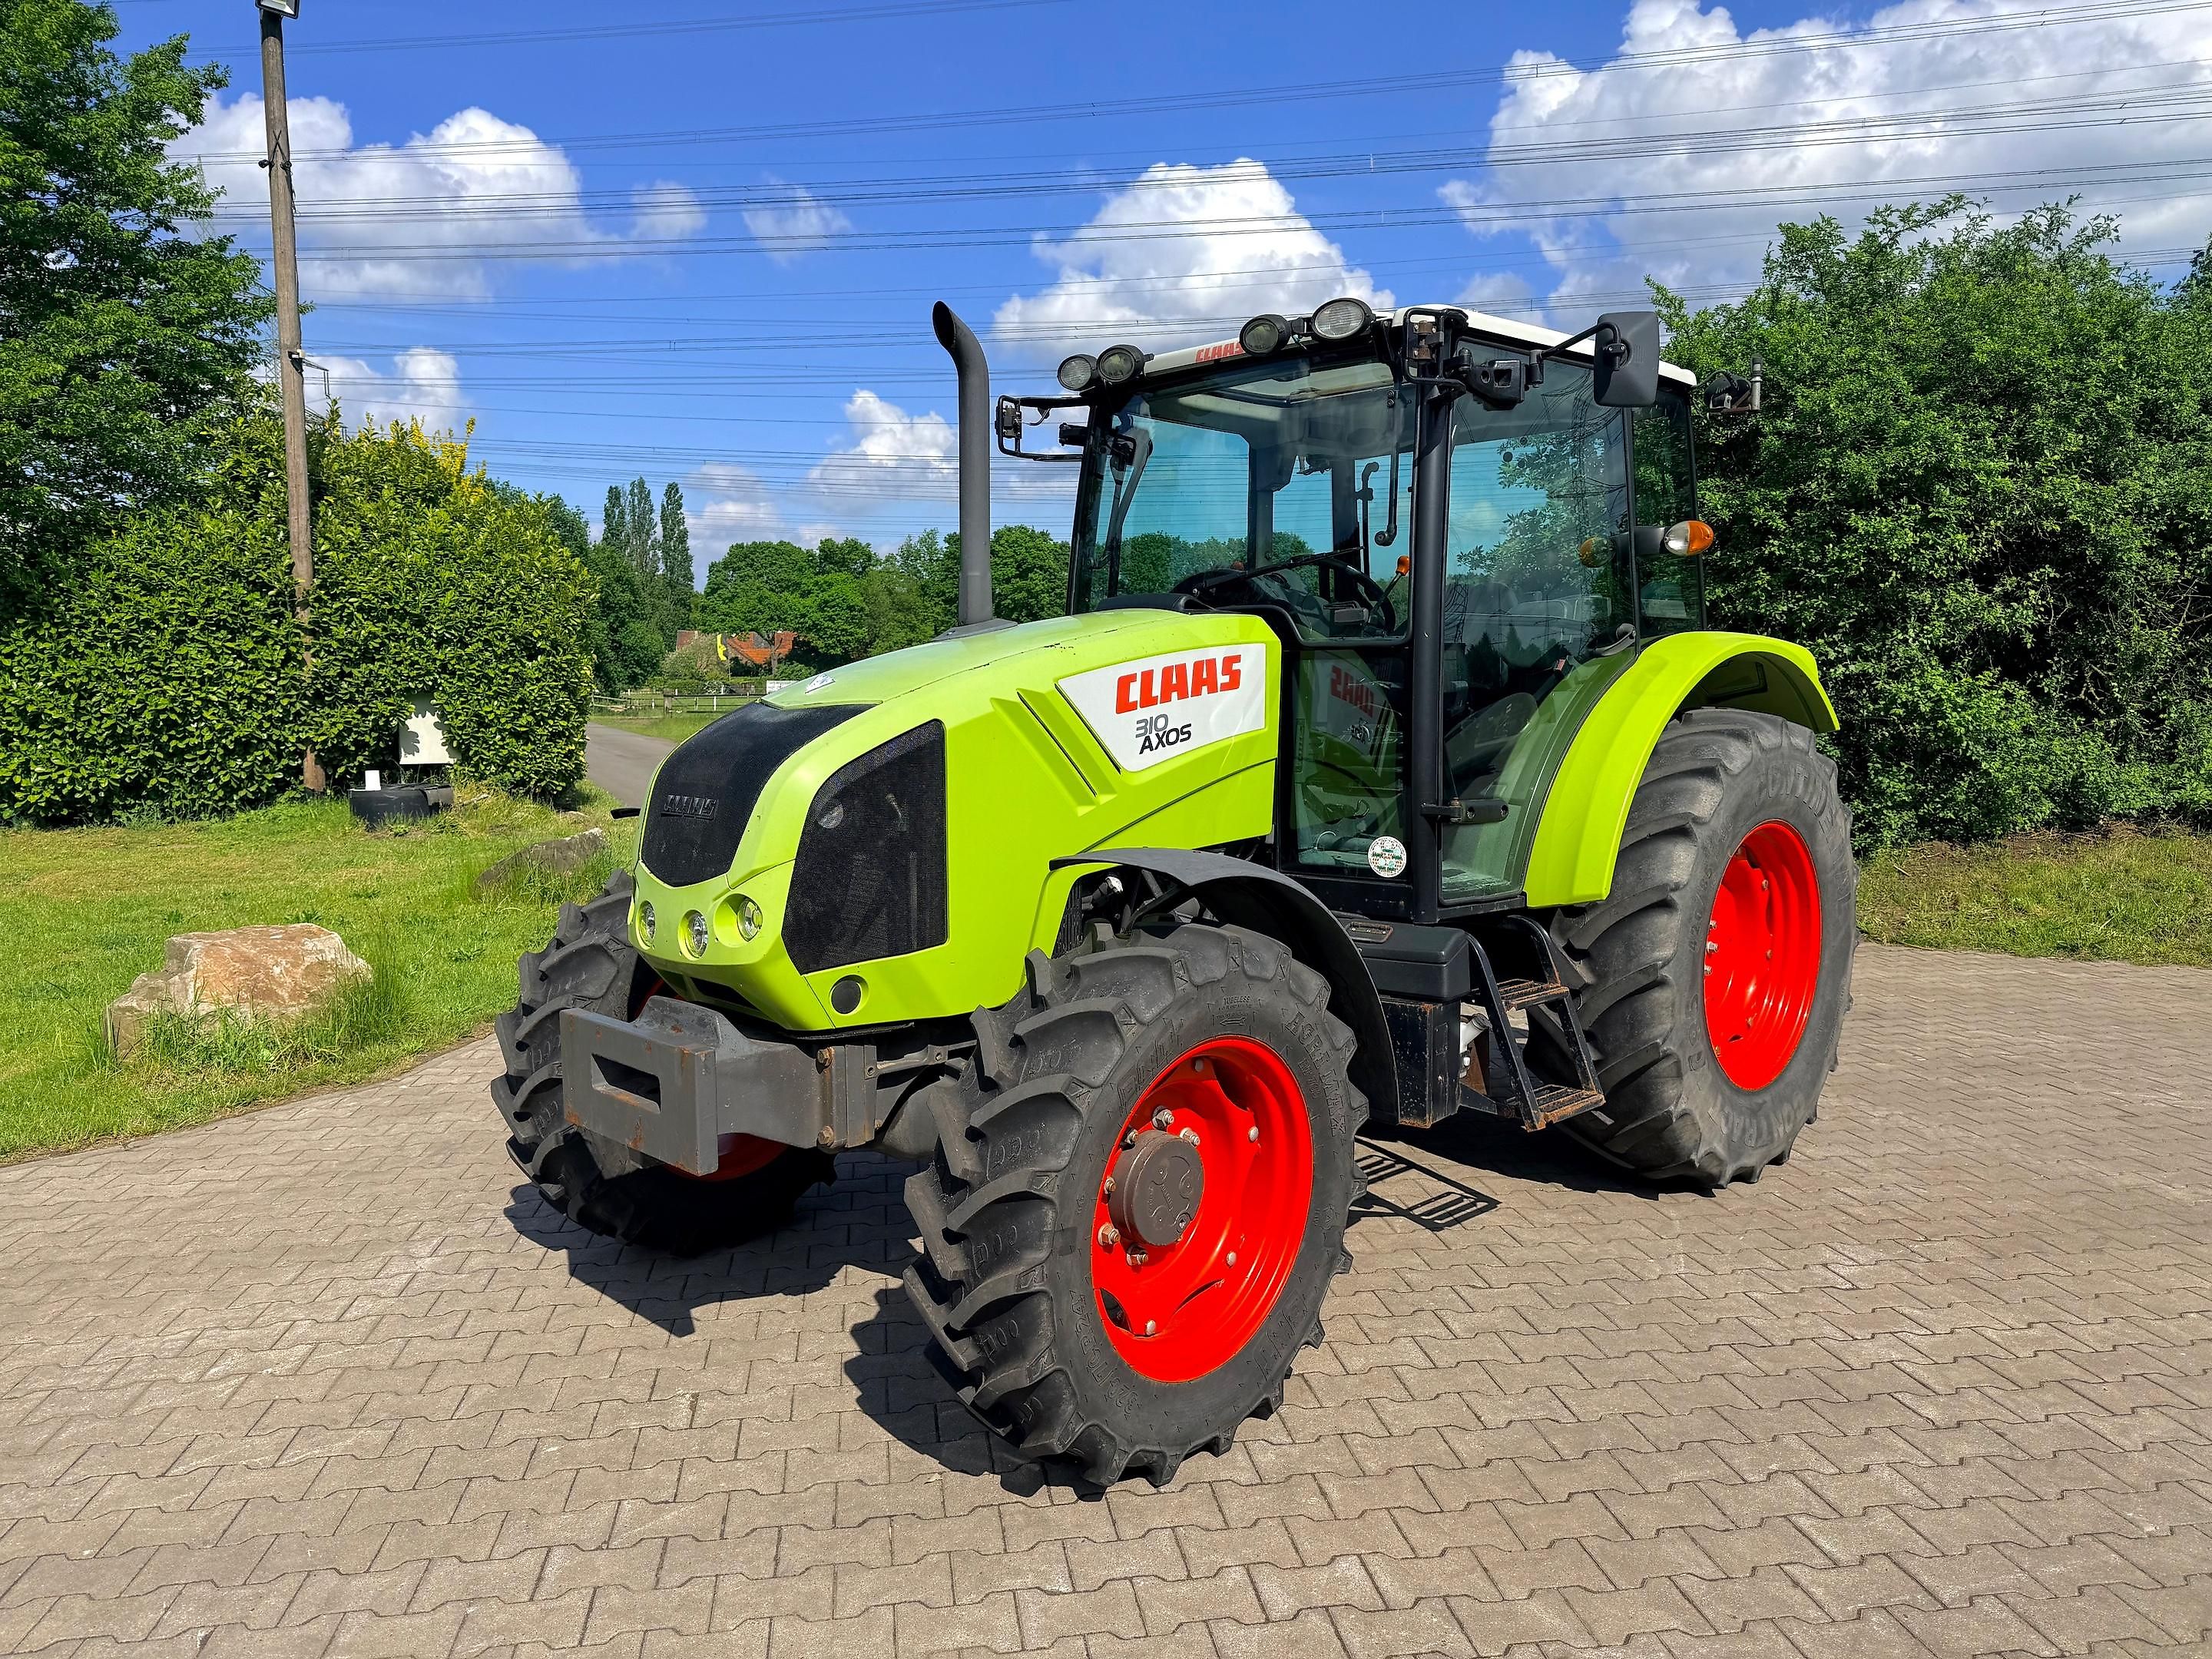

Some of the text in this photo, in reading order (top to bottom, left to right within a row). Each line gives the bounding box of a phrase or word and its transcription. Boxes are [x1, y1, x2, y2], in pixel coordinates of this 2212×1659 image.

[1195, 341, 1243, 363] CLAAS
[1115, 654, 1241, 714] CLAAS
[1135, 714, 1168, 738] 310
[1139, 723, 1191, 754] AXOS
